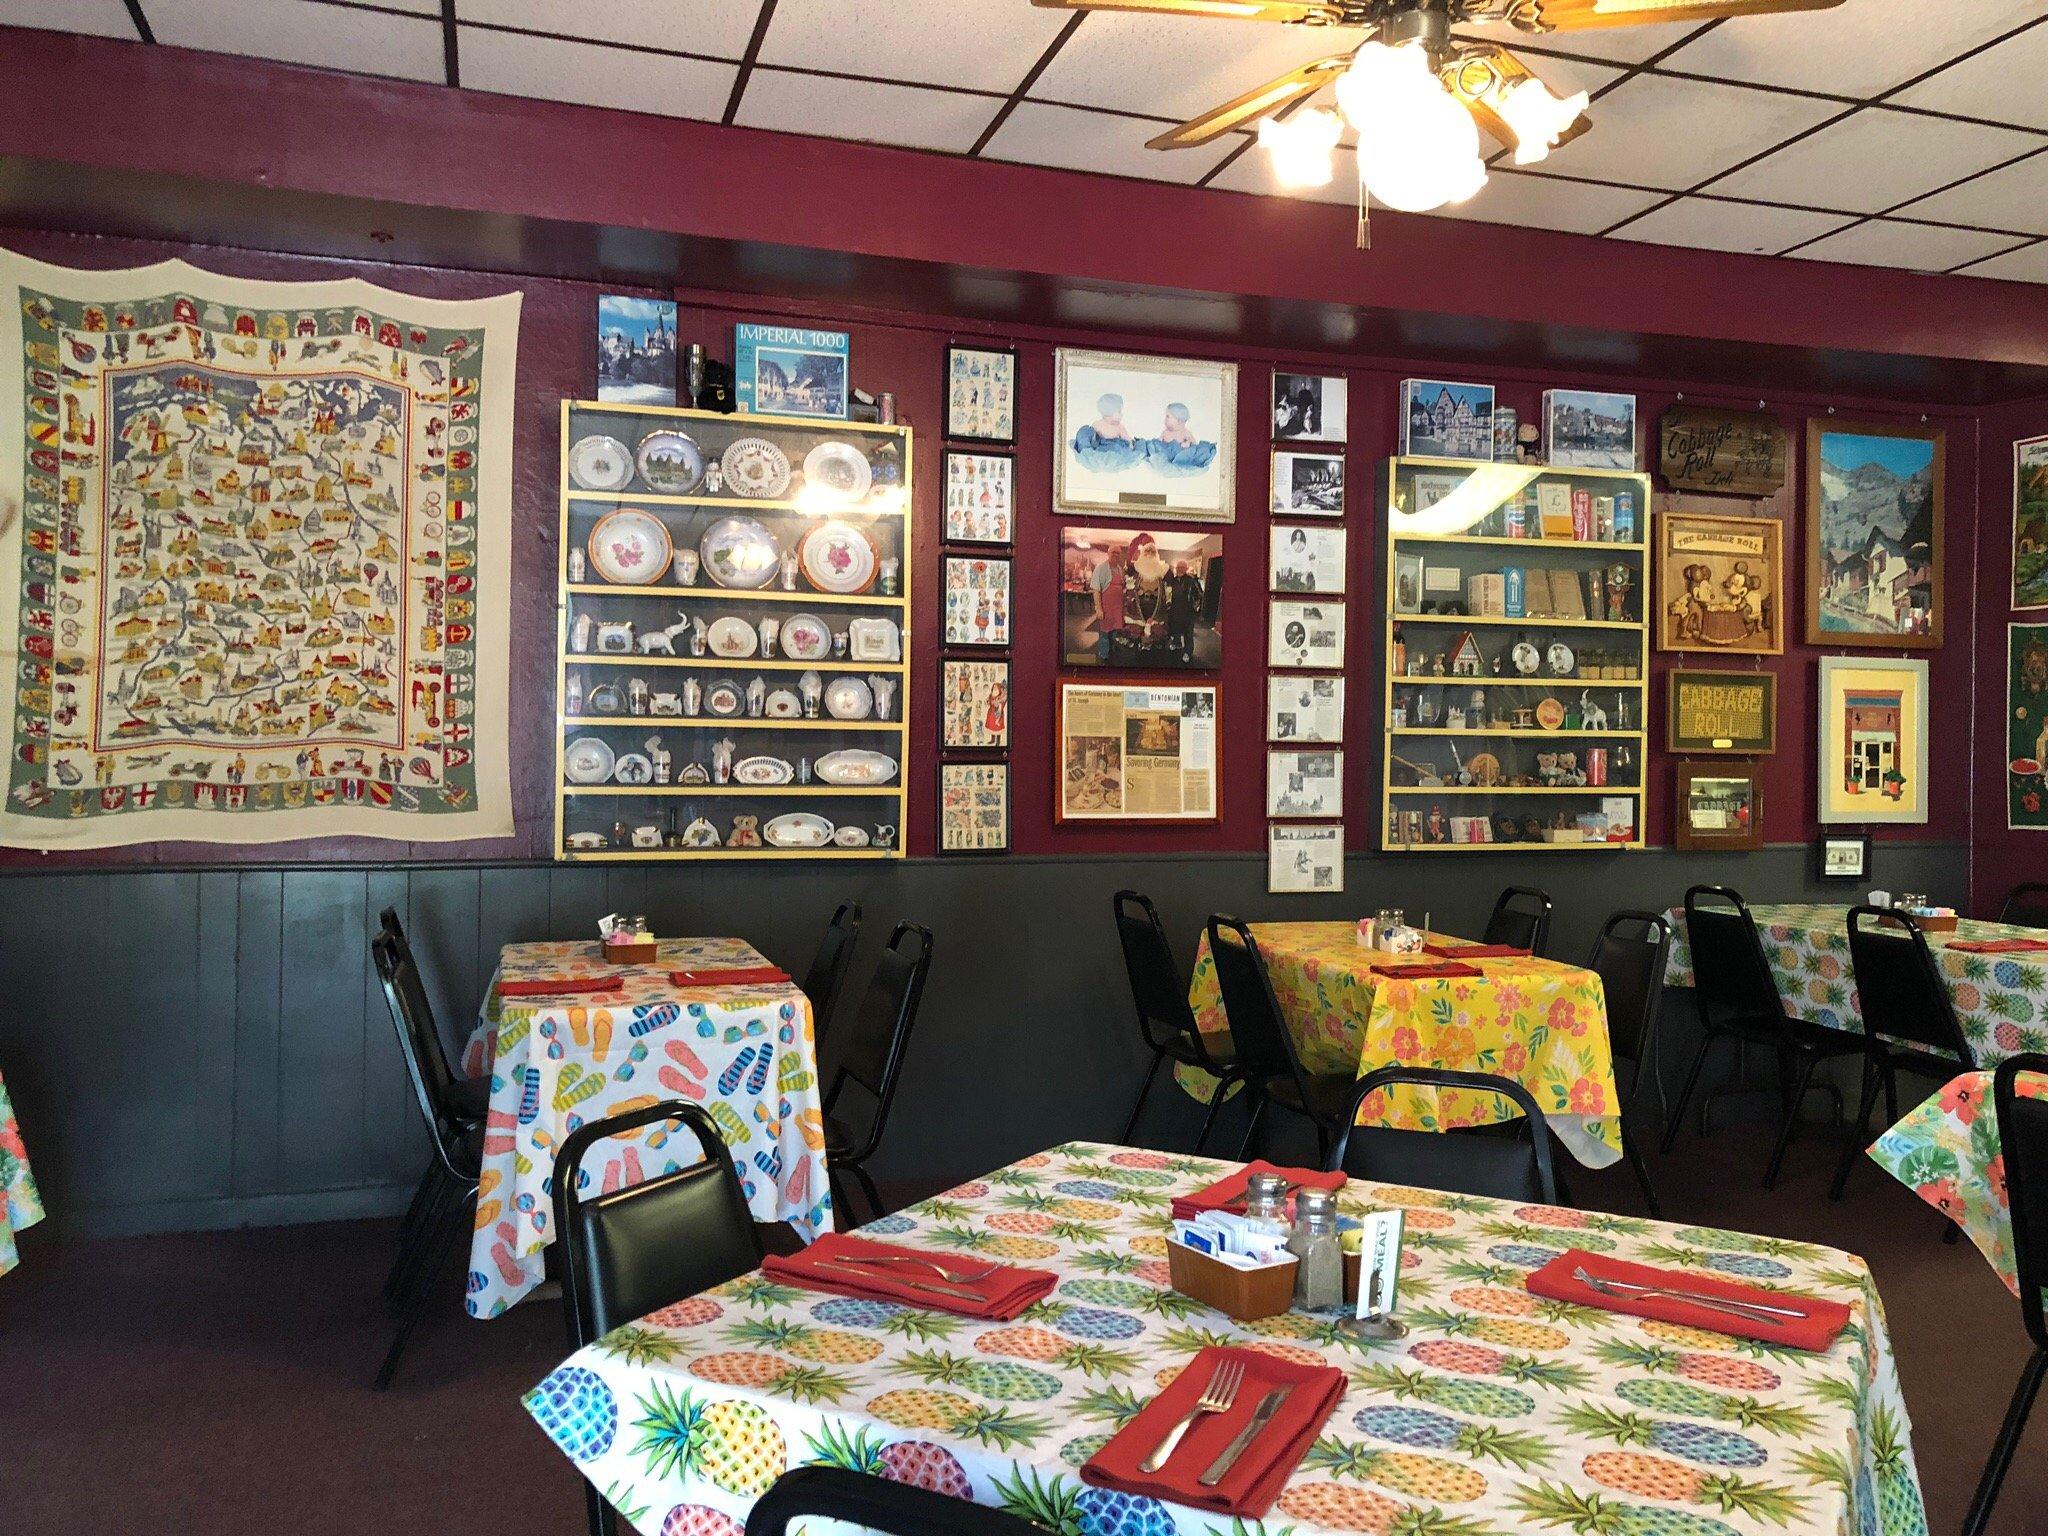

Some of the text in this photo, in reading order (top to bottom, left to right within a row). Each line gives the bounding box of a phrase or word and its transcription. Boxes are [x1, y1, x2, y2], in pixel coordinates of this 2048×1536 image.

[741, 325, 845, 348] IMPERIAL 1000
[1668, 422, 1732, 459] Cabbage
[1677, 445, 1716, 480] Roll
[1696, 533, 1734, 544] CABBAGE
[1737, 537, 1758, 551] ROLL
[1680, 685, 1762, 713] CABBAGE
[1694, 713, 1740, 737] ROLL
[1126, 757, 1180, 770] Savoring Germany
[1377, 1220, 1388, 1272] MEAL?
